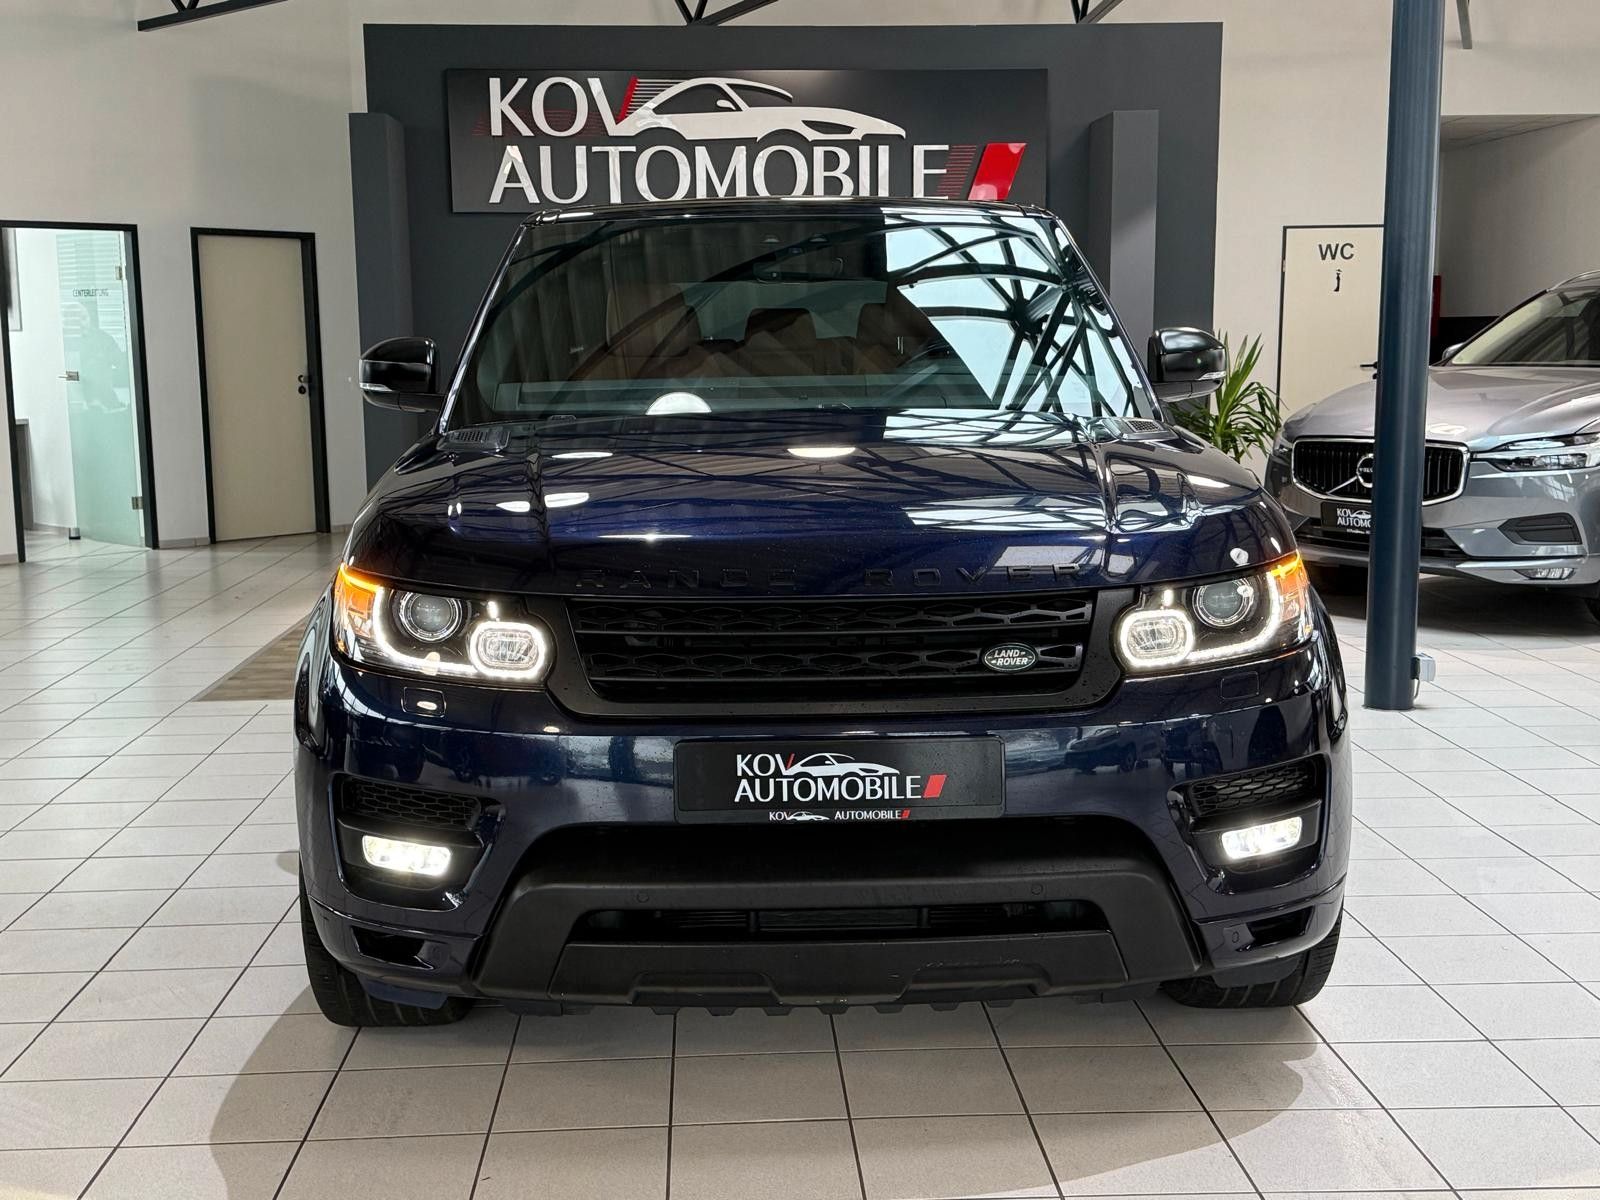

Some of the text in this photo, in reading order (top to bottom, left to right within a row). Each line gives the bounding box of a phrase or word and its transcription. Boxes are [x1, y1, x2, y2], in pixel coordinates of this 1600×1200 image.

[488, 76, 638, 137] KOV
[488, 144, 950, 203] AUTOMOBILE
[1318, 242, 1354, 261] WC
[864, 563, 1082, 587] ROVER
[994, 649, 1020, 658] LAND
[996, 657, 1029, 666] ROVER
[736, 753, 795, 777] KOV
[734, 774, 922, 803] AUTOMOBILE
[769, 810, 902, 821] KOV AUTOMOBILE
